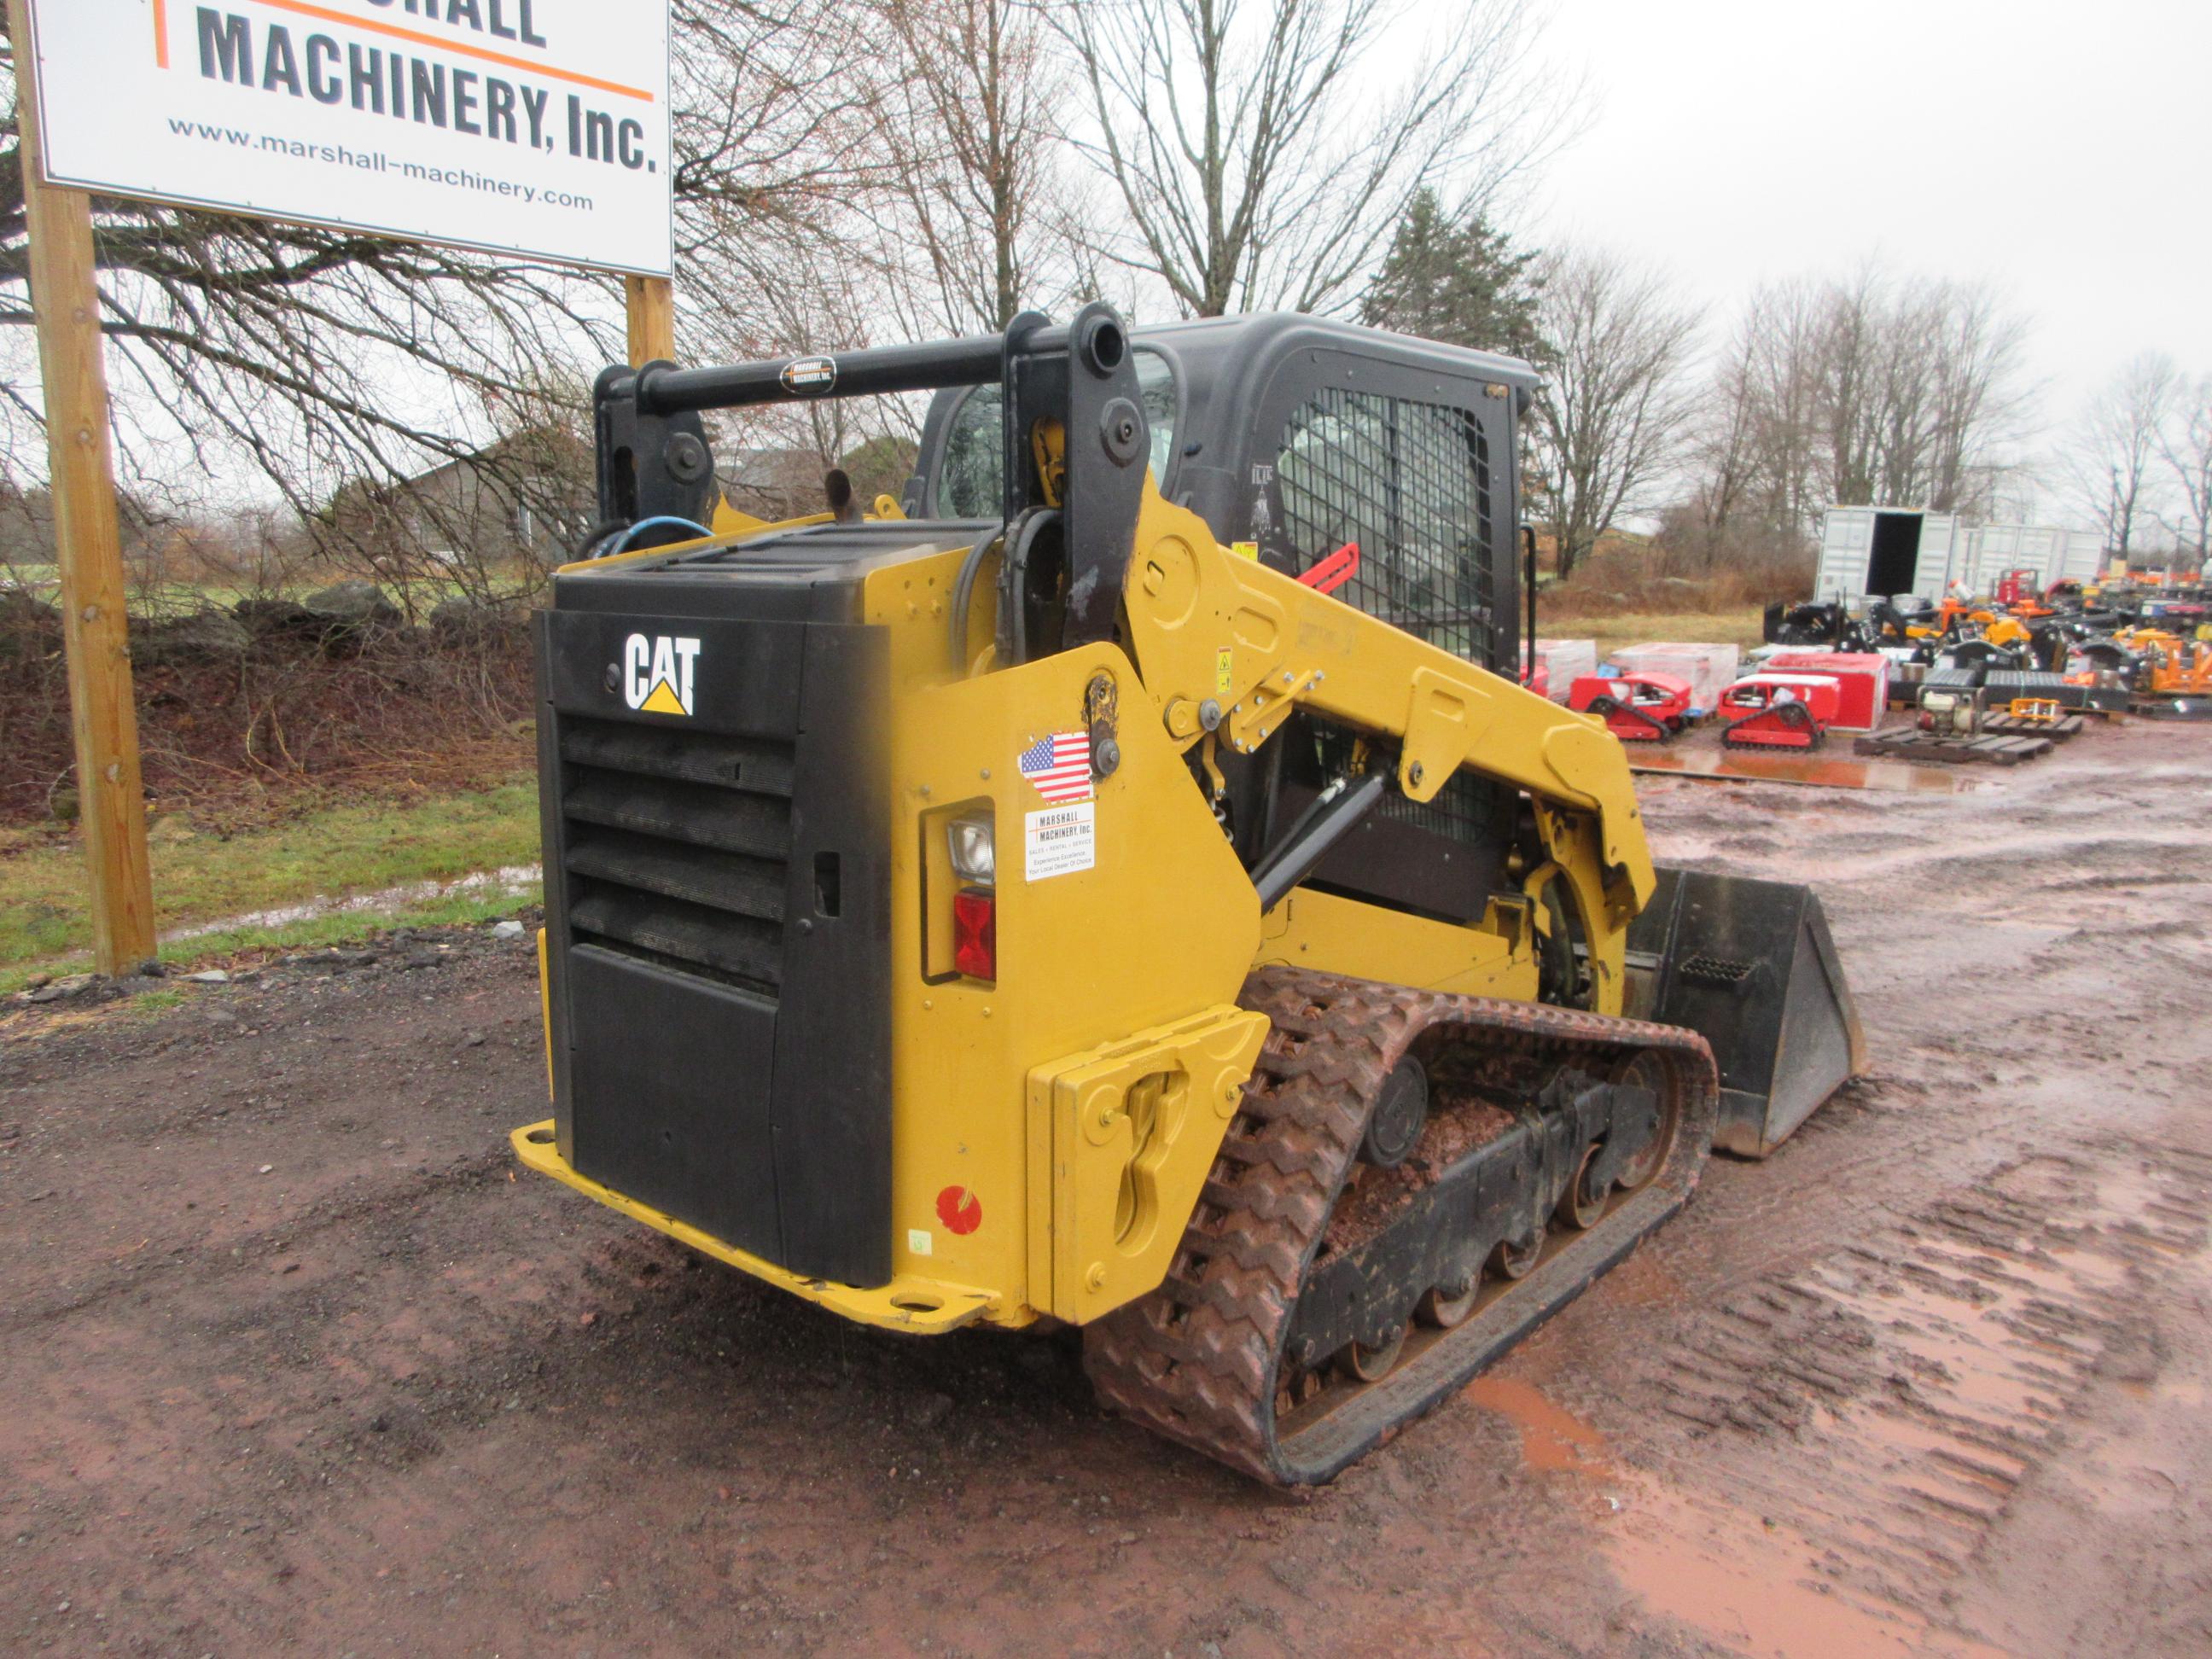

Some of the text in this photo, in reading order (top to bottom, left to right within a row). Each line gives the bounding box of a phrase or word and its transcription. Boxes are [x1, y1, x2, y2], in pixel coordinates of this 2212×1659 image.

[195, 5, 555, 156] MACHINERY,
[567, 93, 657, 173] Inc.
[167, 117, 595, 212] www.marshall-machinery.com
[626, 632, 701, 716] CAT
[1033, 851, 1086, 866] Experience Excellence
[1039, 811, 1078, 827] MARSHALL
